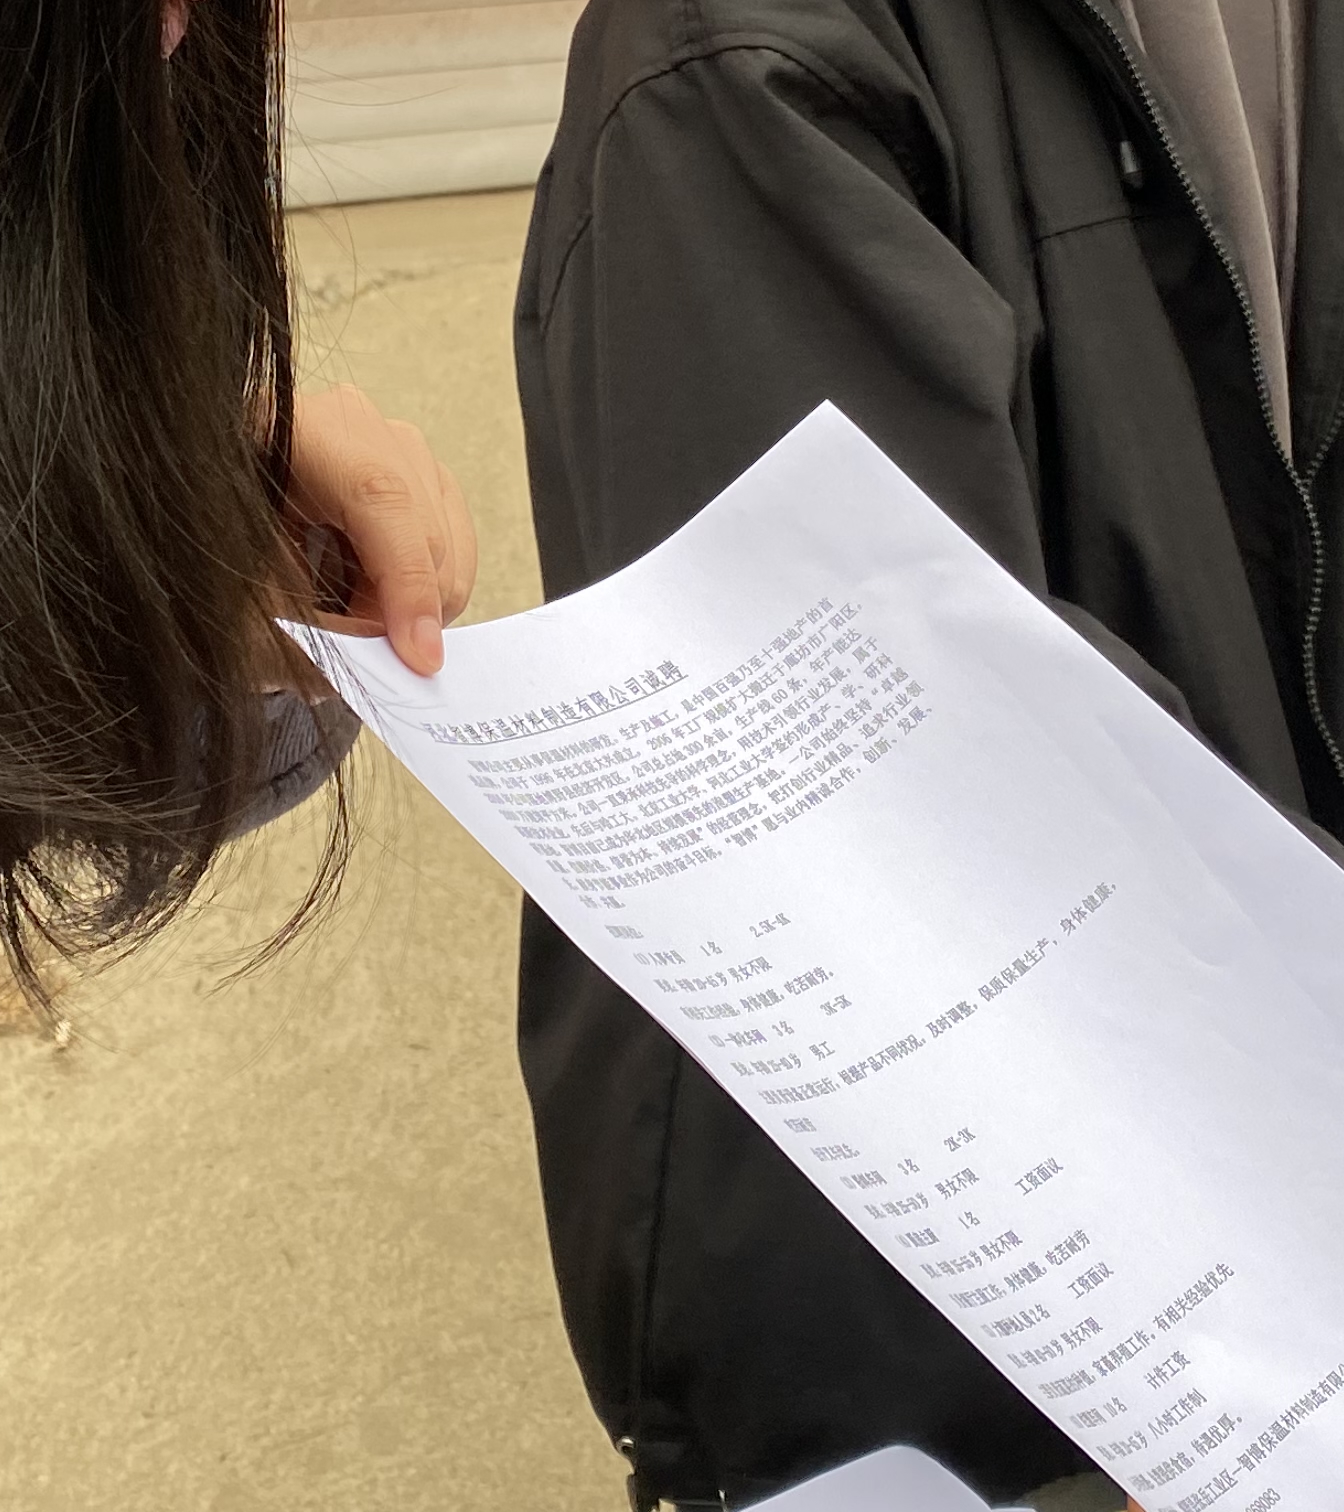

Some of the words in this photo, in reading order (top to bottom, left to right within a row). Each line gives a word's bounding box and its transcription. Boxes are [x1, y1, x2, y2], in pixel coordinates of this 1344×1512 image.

[1015, 1157, 1064, 1196] 工资面议
[1067, 1261, 1114, 1299] 工资面议
[1143, 1350, 1191, 1390] 计件工资
